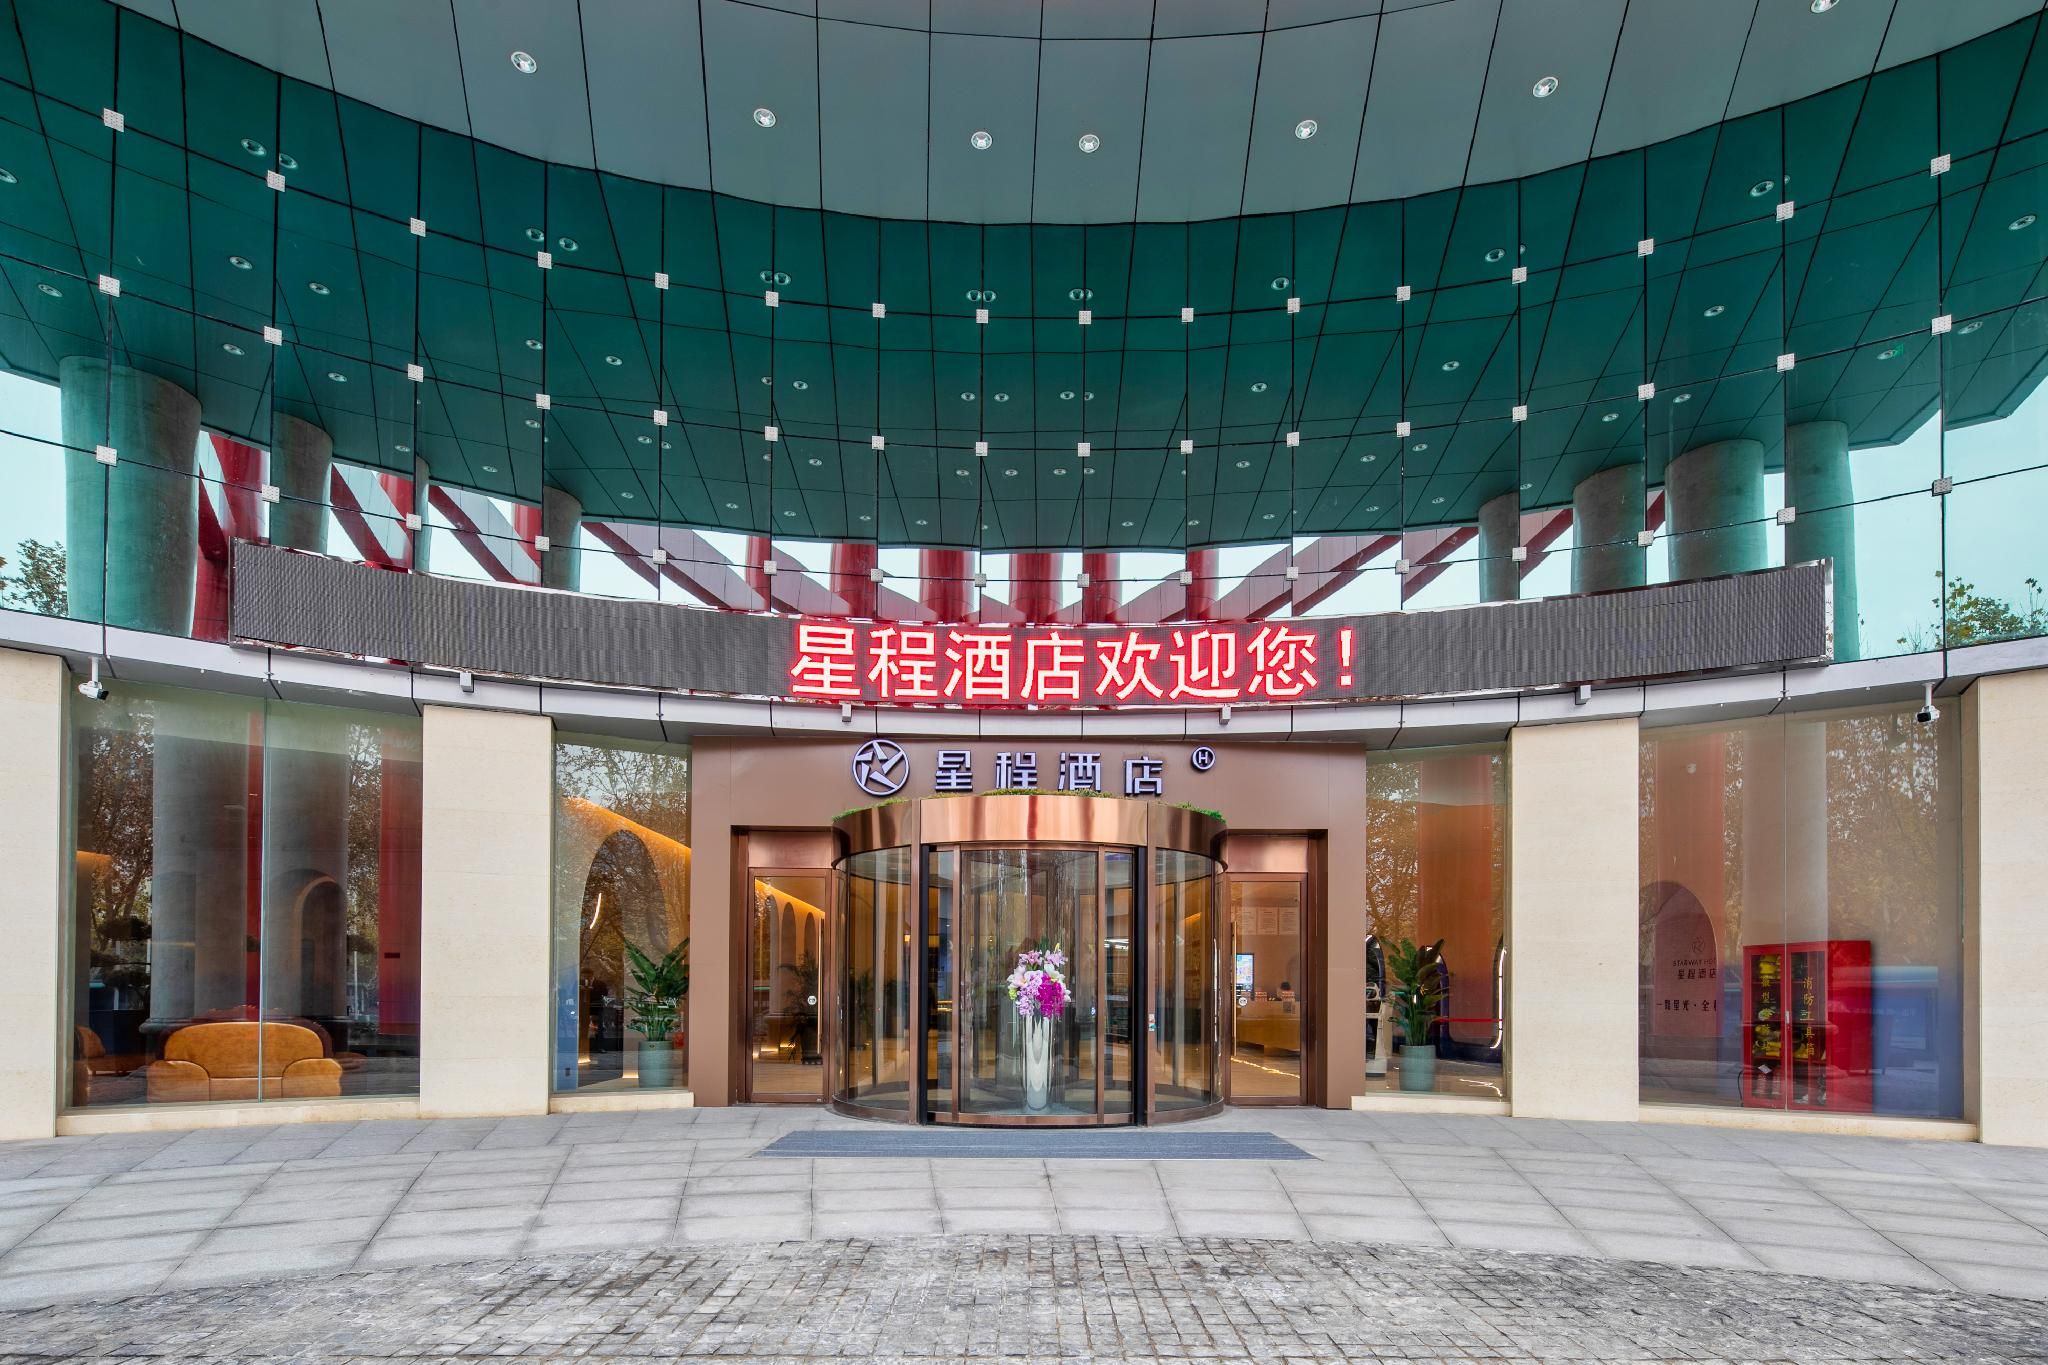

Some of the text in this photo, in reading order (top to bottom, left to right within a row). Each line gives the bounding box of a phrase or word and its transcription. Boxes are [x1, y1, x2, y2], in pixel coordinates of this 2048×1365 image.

[790, 625, 1352, 700] 星程酒店欢迎您!
[935, 749, 1163, 795] 星程酒店
[1678, 967, 1717, 980] 星程酒店
